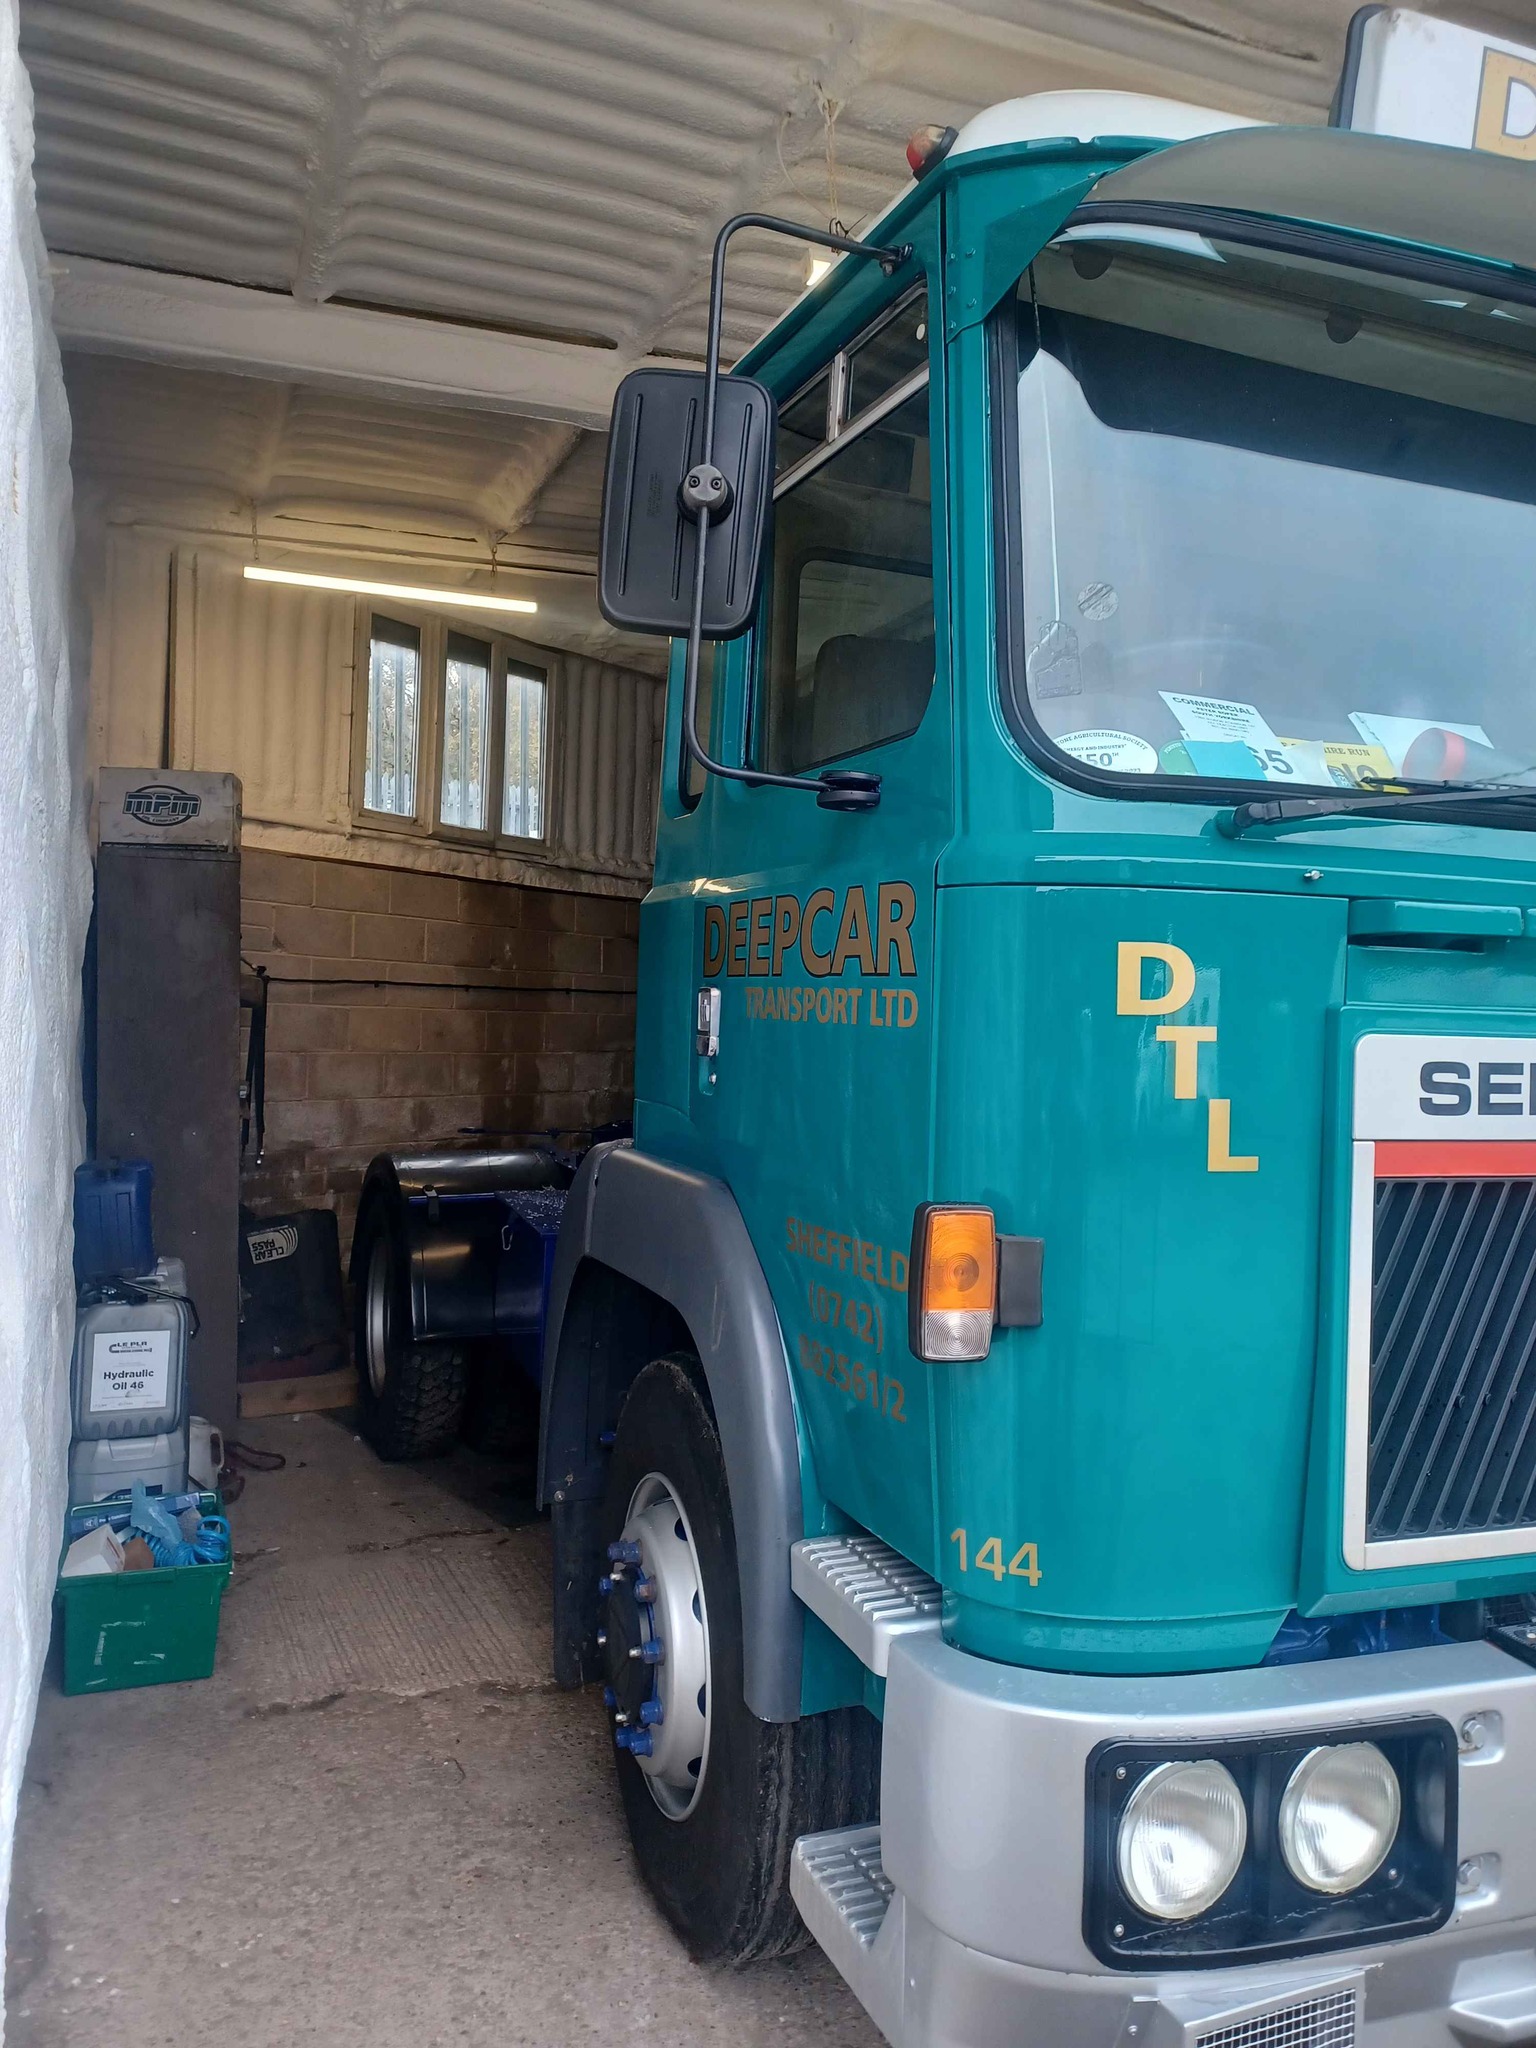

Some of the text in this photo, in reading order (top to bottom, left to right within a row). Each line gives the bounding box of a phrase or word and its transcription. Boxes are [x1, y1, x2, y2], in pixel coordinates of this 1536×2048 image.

[1172, 697, 1255, 715] COMMERCIAL
[1074, 732, 1121, 740] AGRICULTURAL
[1122, 735, 1148, 750] SOCIETY
[1347, 748, 1370, 756] RUN
[703, 880, 918, 977] DEEPCAR
[1116, 941, 1196, 1016] D
[745, 986, 919, 1028] TRANSPORT LTD
[1156, 1025, 1218, 1099] T
[1419, 1061, 1536, 1116] SE
[1207, 1098, 1259, 1173] L
[251, 1238, 276, 1252] PASS
[254, 1246, 285, 1261] CLEAR
[786, 1216, 909, 1292] SHEFFIELD
[103, 1369, 154, 1380] Hydraulic
[112, 1381, 144, 1390] Oil 46
[950, 1527, 1043, 1587] 144
